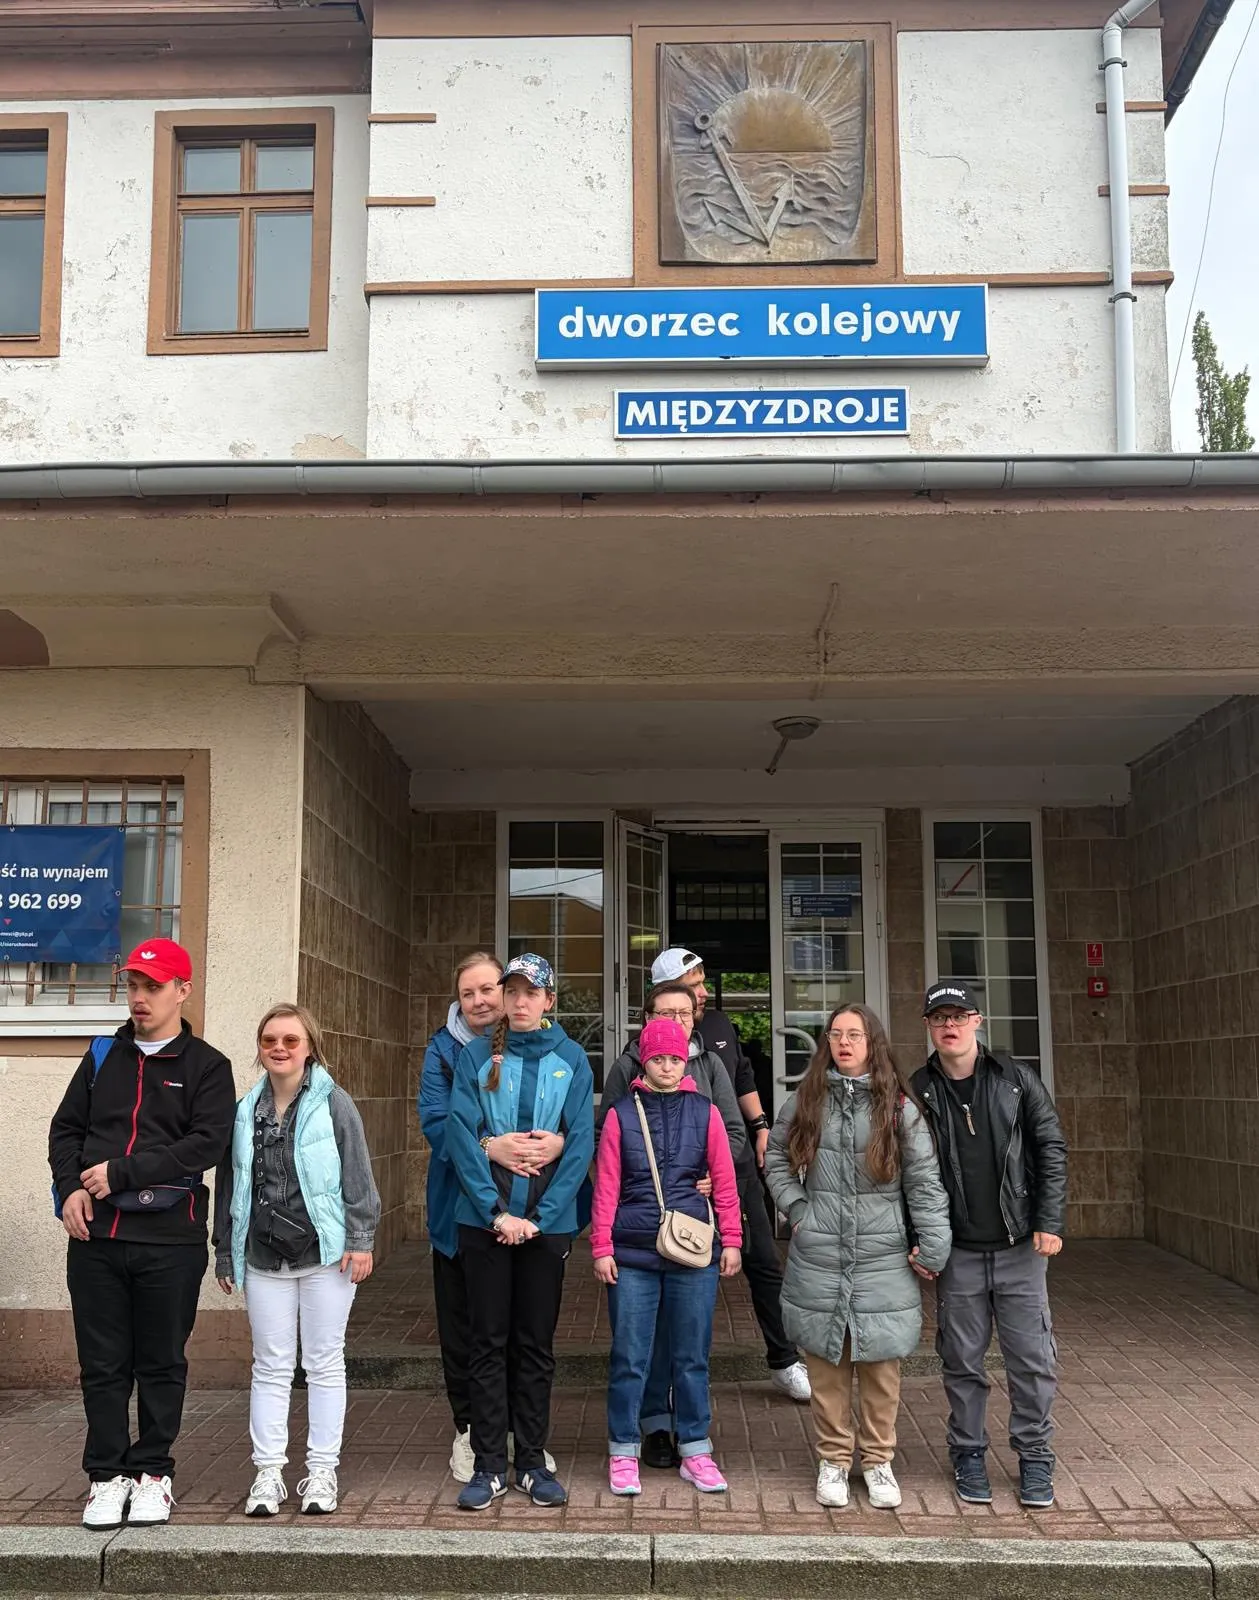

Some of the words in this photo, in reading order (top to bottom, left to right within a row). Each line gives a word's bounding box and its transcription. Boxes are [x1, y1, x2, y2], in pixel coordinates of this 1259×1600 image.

[558, 306, 740, 338] dworzec
[767, 302, 961, 341] kolejowy
[624, 396, 900, 432] MIĘDZYZDROJE
[20, 867, 39, 878] na
[42, 864, 109, 882] wynajem
[8, 893, 42, 910] 962
[47, 893, 82, 910] 699
